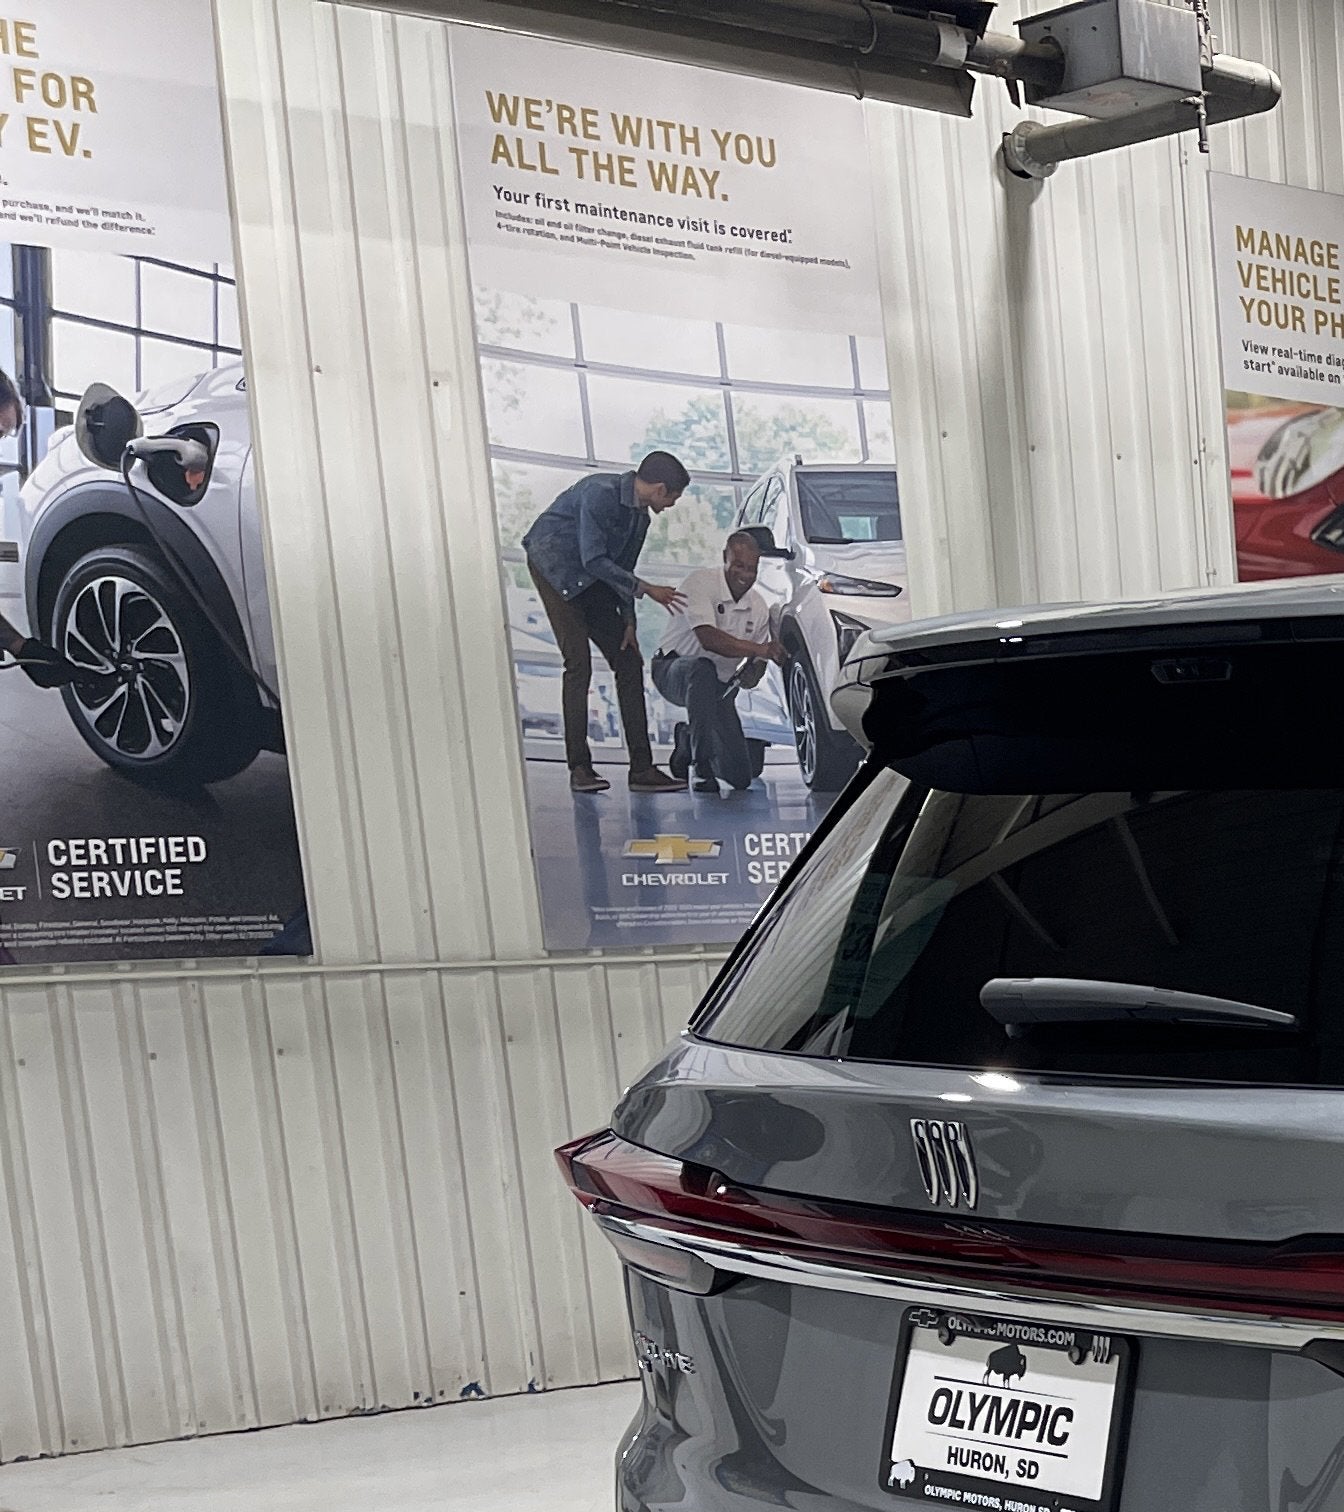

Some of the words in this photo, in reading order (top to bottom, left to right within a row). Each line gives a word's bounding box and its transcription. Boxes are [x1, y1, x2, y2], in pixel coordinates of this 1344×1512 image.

[13, 67, 98, 114] FOR
[27, 116, 92, 159] EV.
[485, 90, 600, 141] WE'RE
[610, 112, 701, 157] WITH
[710, 128, 777, 168] YOU
[490, 133, 560, 176] ALL
[568, 146, 637, 188] THE
[646, 158, 729, 202] WAY.
[46, 216, 79, 227] refund
[82, 220, 98, 230] the
[55, 205, 74, 214] and
[101, 210, 133, 220] match
[493, 184, 530, 205] Your
[534, 192, 571, 212] first
[575, 201, 673, 228] maintenance
[678, 215, 710, 234] visit
[714, 219, 726, 235] is
[1235, 225, 1339, 270] MANAGE
[1236, 260, 1341, 304] VEHICLE
[1240, 296, 1306, 333] YOUR
[1242, 339, 1268, 355] View
[1272, 346, 1322, 364] real-time
[1278, 365, 1324, 382] available
[1328, 373, 1340, 384] on
[47, 836, 207, 866] CERTIFIED
[744, 832, 812, 856] CERT
[51, 868, 184, 899] SERVICE
[622, 873, 730, 886] CHEVROLET
[927, 1387, 1074, 1447] OLYMPIC
[947, 1445, 1009, 1479] HURON,
[1016, 1458, 1040, 1480] SD
[924, 1484, 962, 1501] OLYMPIC
[962, 1491, 1002, 1511] MOTORS,
